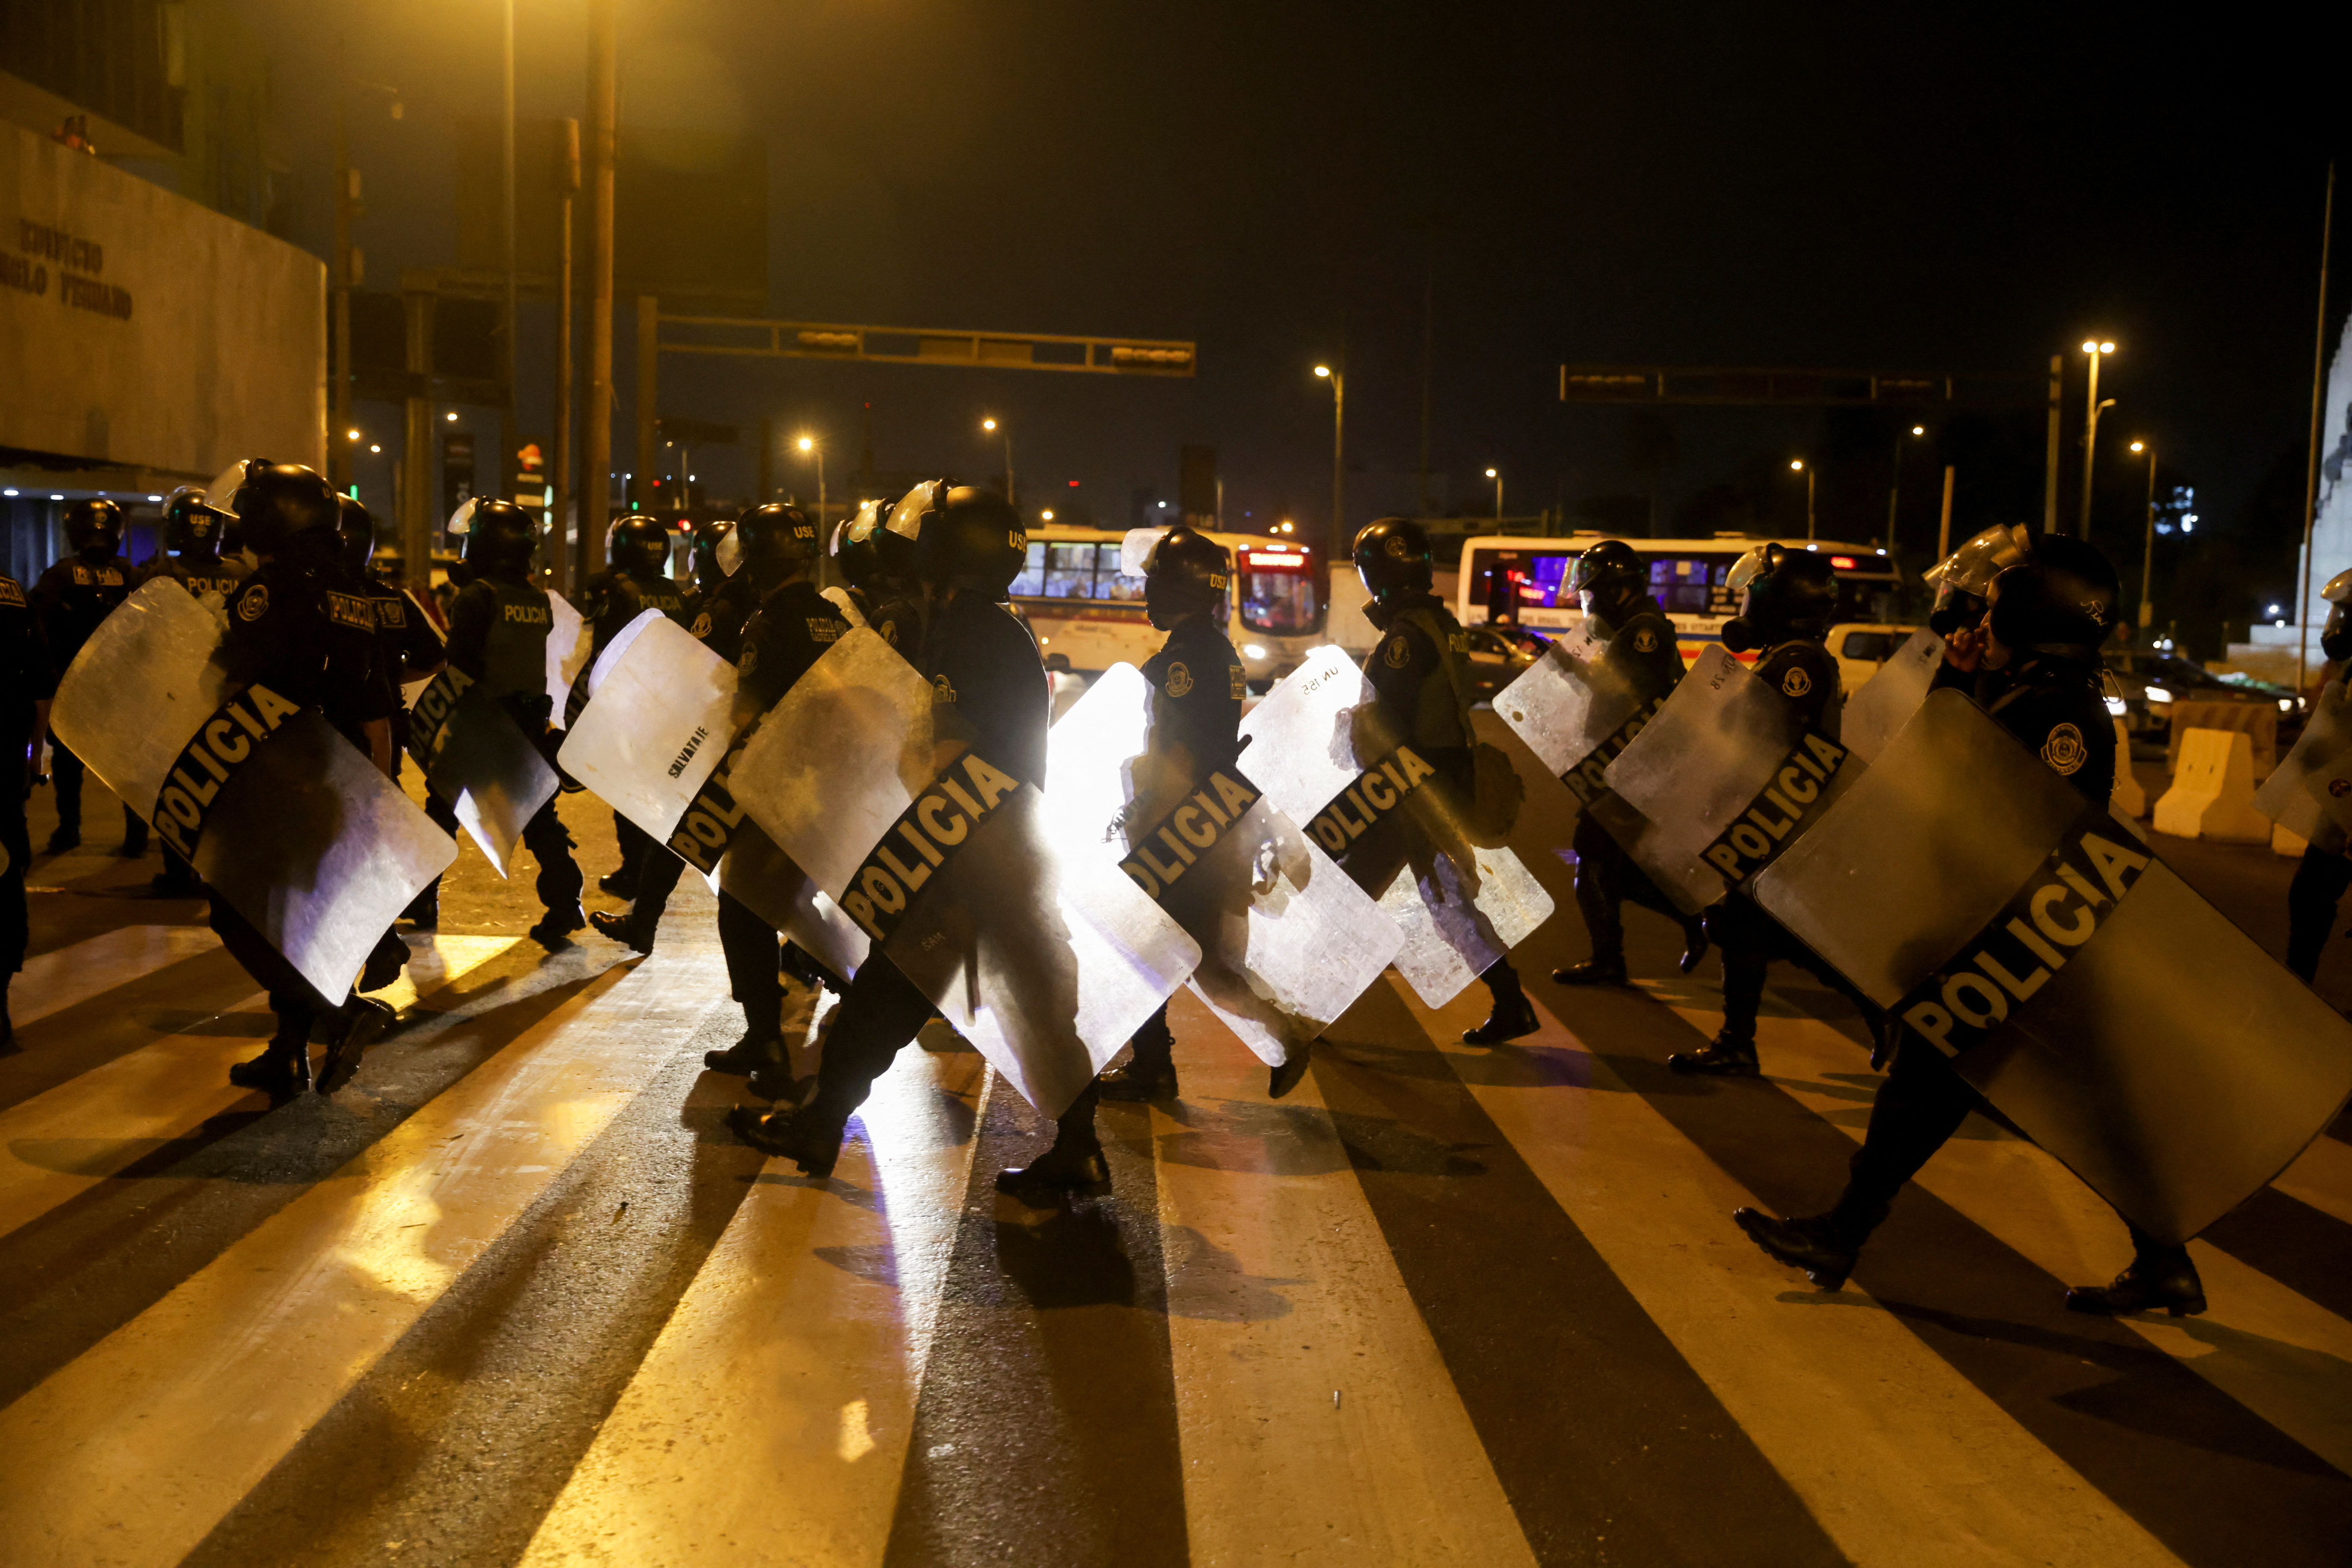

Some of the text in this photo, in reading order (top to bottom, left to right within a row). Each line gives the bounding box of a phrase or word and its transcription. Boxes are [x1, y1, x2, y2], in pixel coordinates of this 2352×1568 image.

[189, 514, 211, 526] USE
[794, 527, 815, 539] USE
[1009, 530, 1027, 553] USE
[1210, 574, 1227, 590] USE
[330, 595, 374, 628] POLICIA
[505, 605, 547, 624] POLICIA
[639, 594, 682, 611] POLICIA
[668, 726, 709, 779] SALVATAJE
[155, 683, 301, 856] POLICIA
[1708, 733, 1844, 879] POLICIA
[844, 754, 1019, 940] POLICIA
[1901, 832, 2151, 1059] POLICIA
